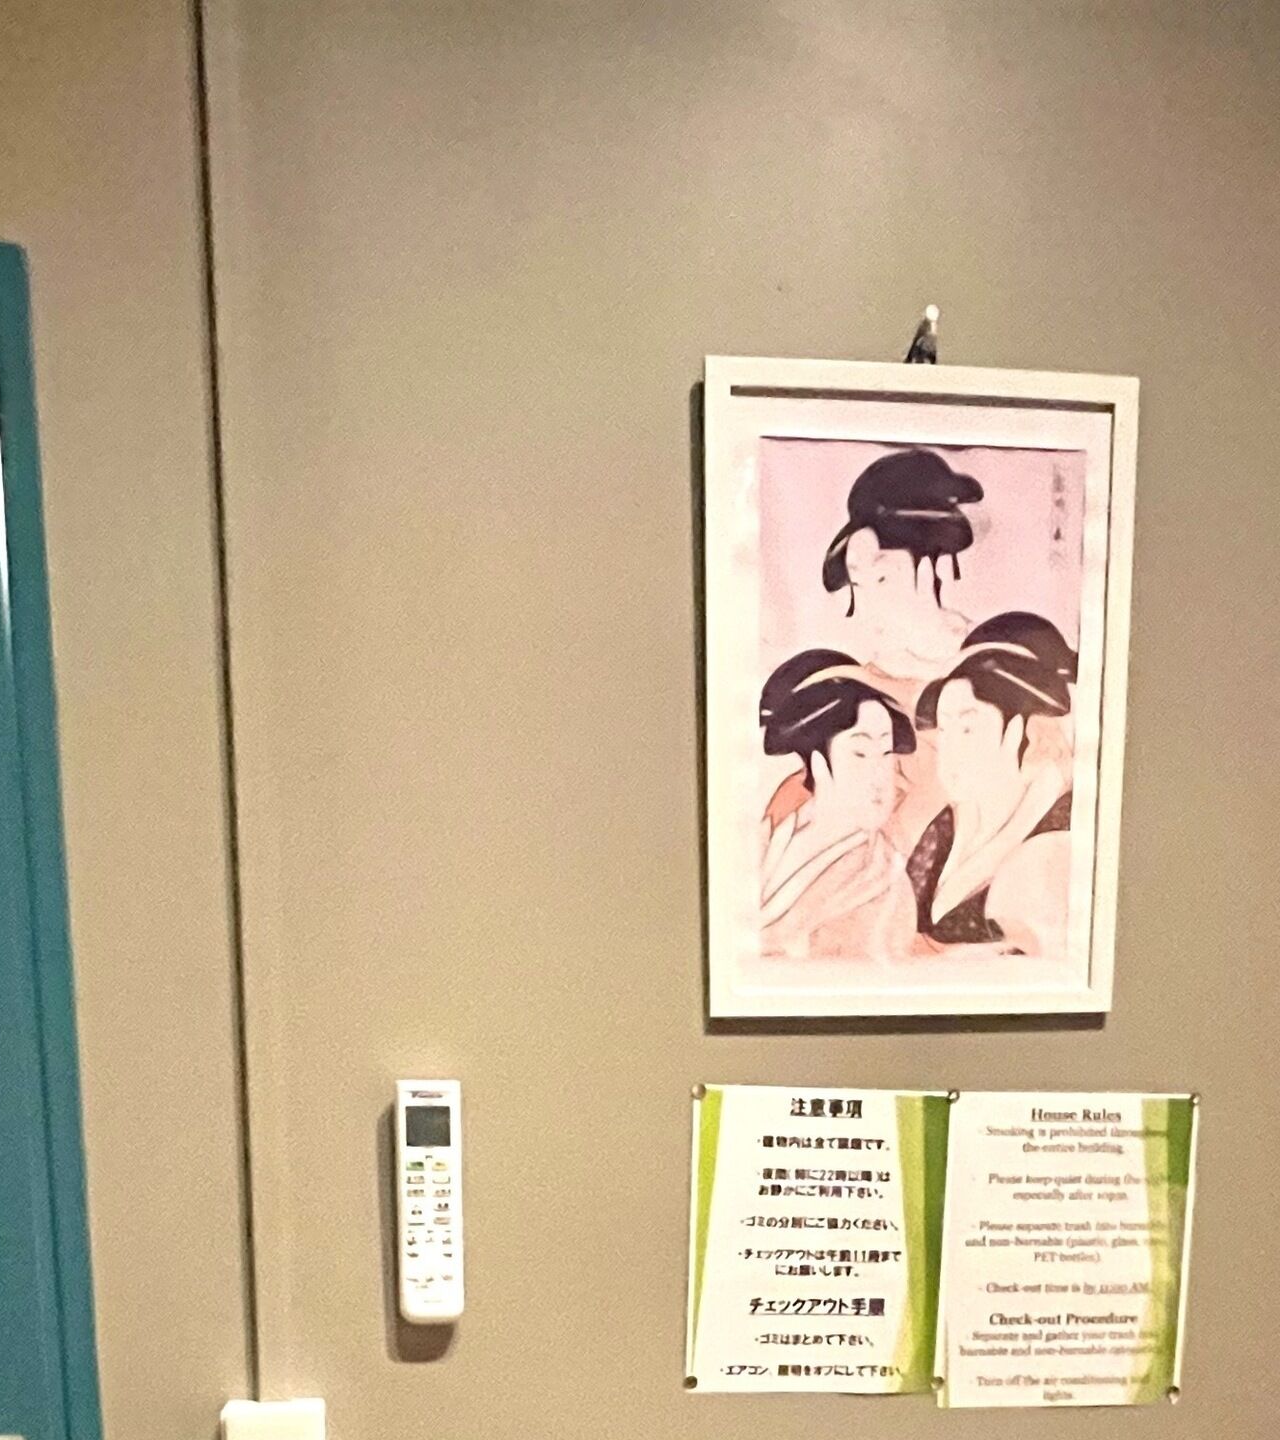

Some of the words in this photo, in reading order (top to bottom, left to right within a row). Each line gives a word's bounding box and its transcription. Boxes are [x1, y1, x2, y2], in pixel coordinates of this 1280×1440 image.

[789, 1097, 863, 1119] 注意事項
[1031, 1108, 1077, 1121] House
[1082, 1108, 1122, 1121] Rules
[985, 1126, 1034, 1139] Smoking
[1050, 1126, 1107, 1139] prohibited
[988, 1173, 1023, 1184] Please
[1025, 1174, 1052, 1186] keep
[1053, 1174, 1082, 1186] quiet
[979, 1221, 1014, 1231] Please
[1064, 1221, 1092, 1231] trash
[965, 1235, 986, 1247] and
[989, 1236, 1063, 1247] non-burnable
[1033, 1252, 1056, 1262] PET
[986, 1282, 1042, 1293] Check-out
[1045, 1282, 1068, 1293] time
[749, 1297, 886, 1315] チェックアウト手順
[988, 1313, 1061, 1325] Check-out
[1066, 1312, 1138, 1325] Procedure
[972, 1331, 1019, 1342] Separate
[1022, 1330, 1043, 1341] and
[976, 1375, 1003, 1386] Turn
